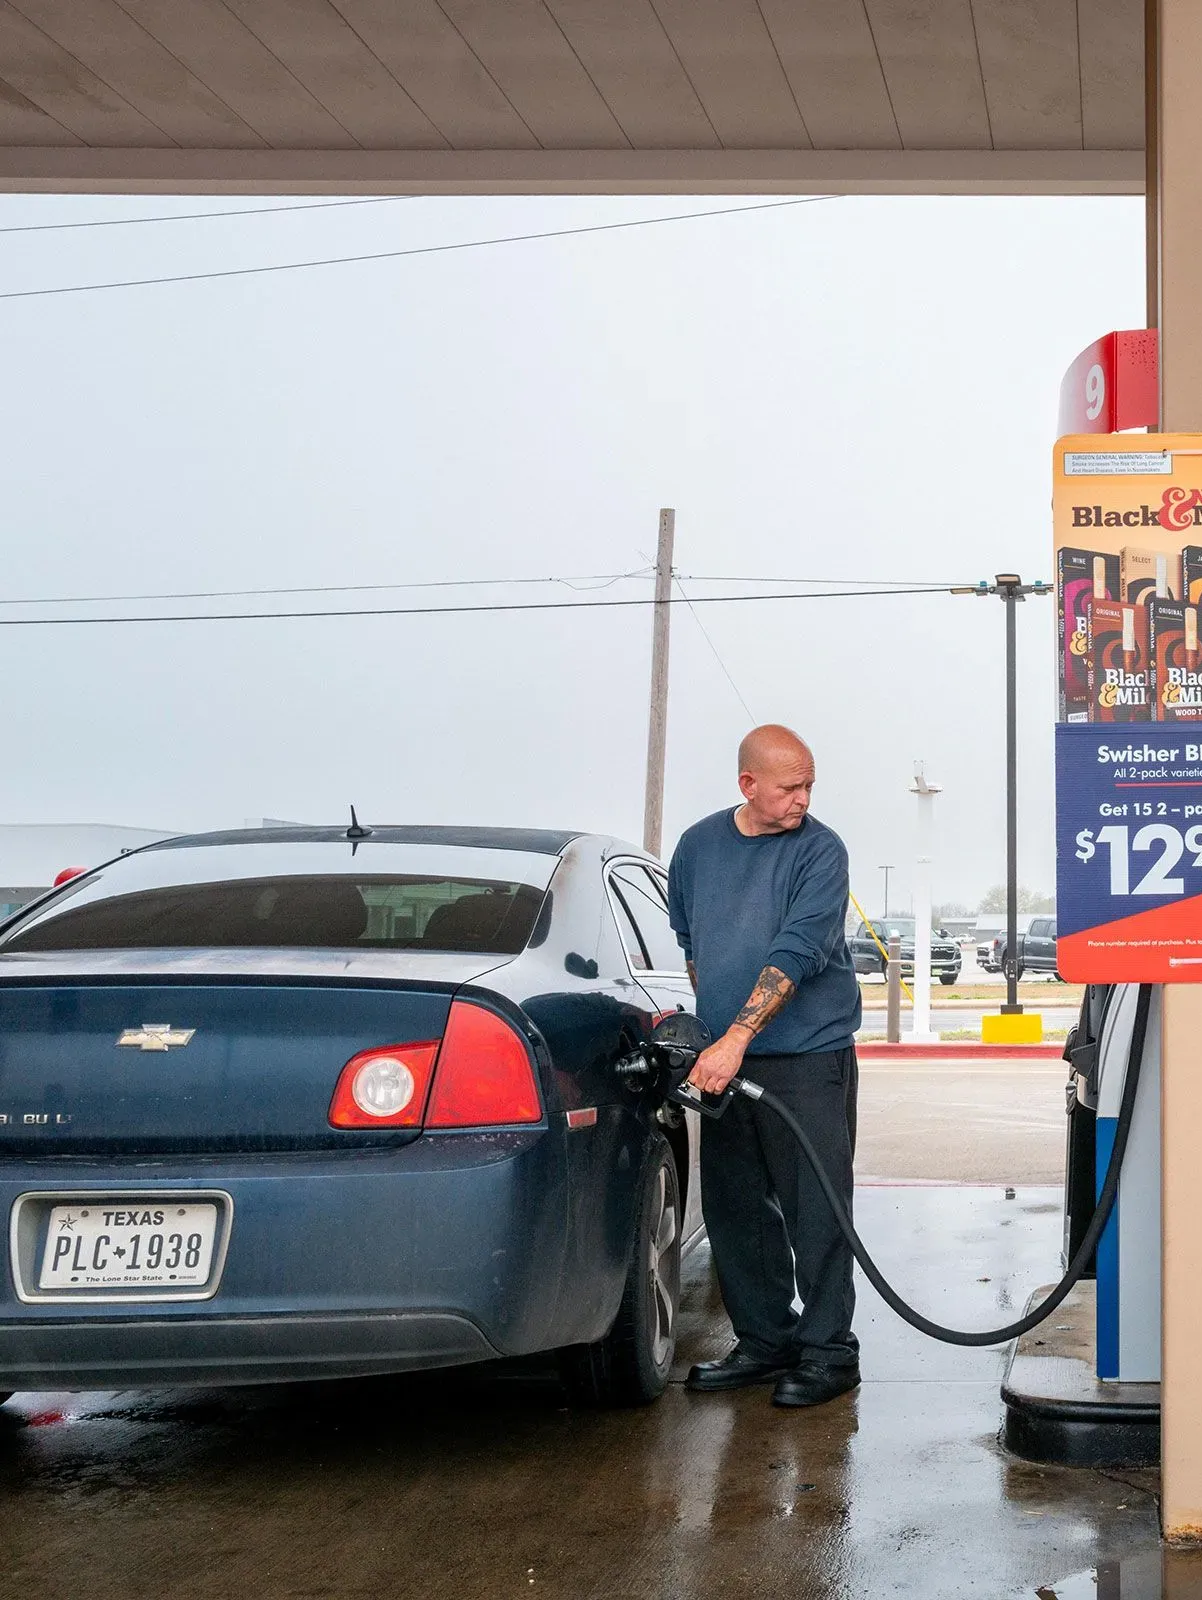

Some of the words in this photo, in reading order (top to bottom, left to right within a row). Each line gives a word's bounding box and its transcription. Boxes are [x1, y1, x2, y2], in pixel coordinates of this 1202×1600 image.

[1086, 364, 1105, 420] 9
[1072, 557, 1086, 565] WINE
[1131, 556, 1151, 564] SELECT
[1096, 607, 1120, 617] ORIGINAL
[1158, 607, 1183, 617] ORIGINAL
[1175, 708, 1196, 716] WOOD
[1097, 744, 1179, 763] Swisher
[1114, 767, 1126, 778] All
[1129, 766, 1168, 780] 2-pack
[1099, 803, 1128, 816] Get
[1133, 803, 1152, 816] 15
[1157, 802, 1167, 815] 2
[1128, 940, 1150, 948] required
[102, 1210, 165, 1227] TEXAS
